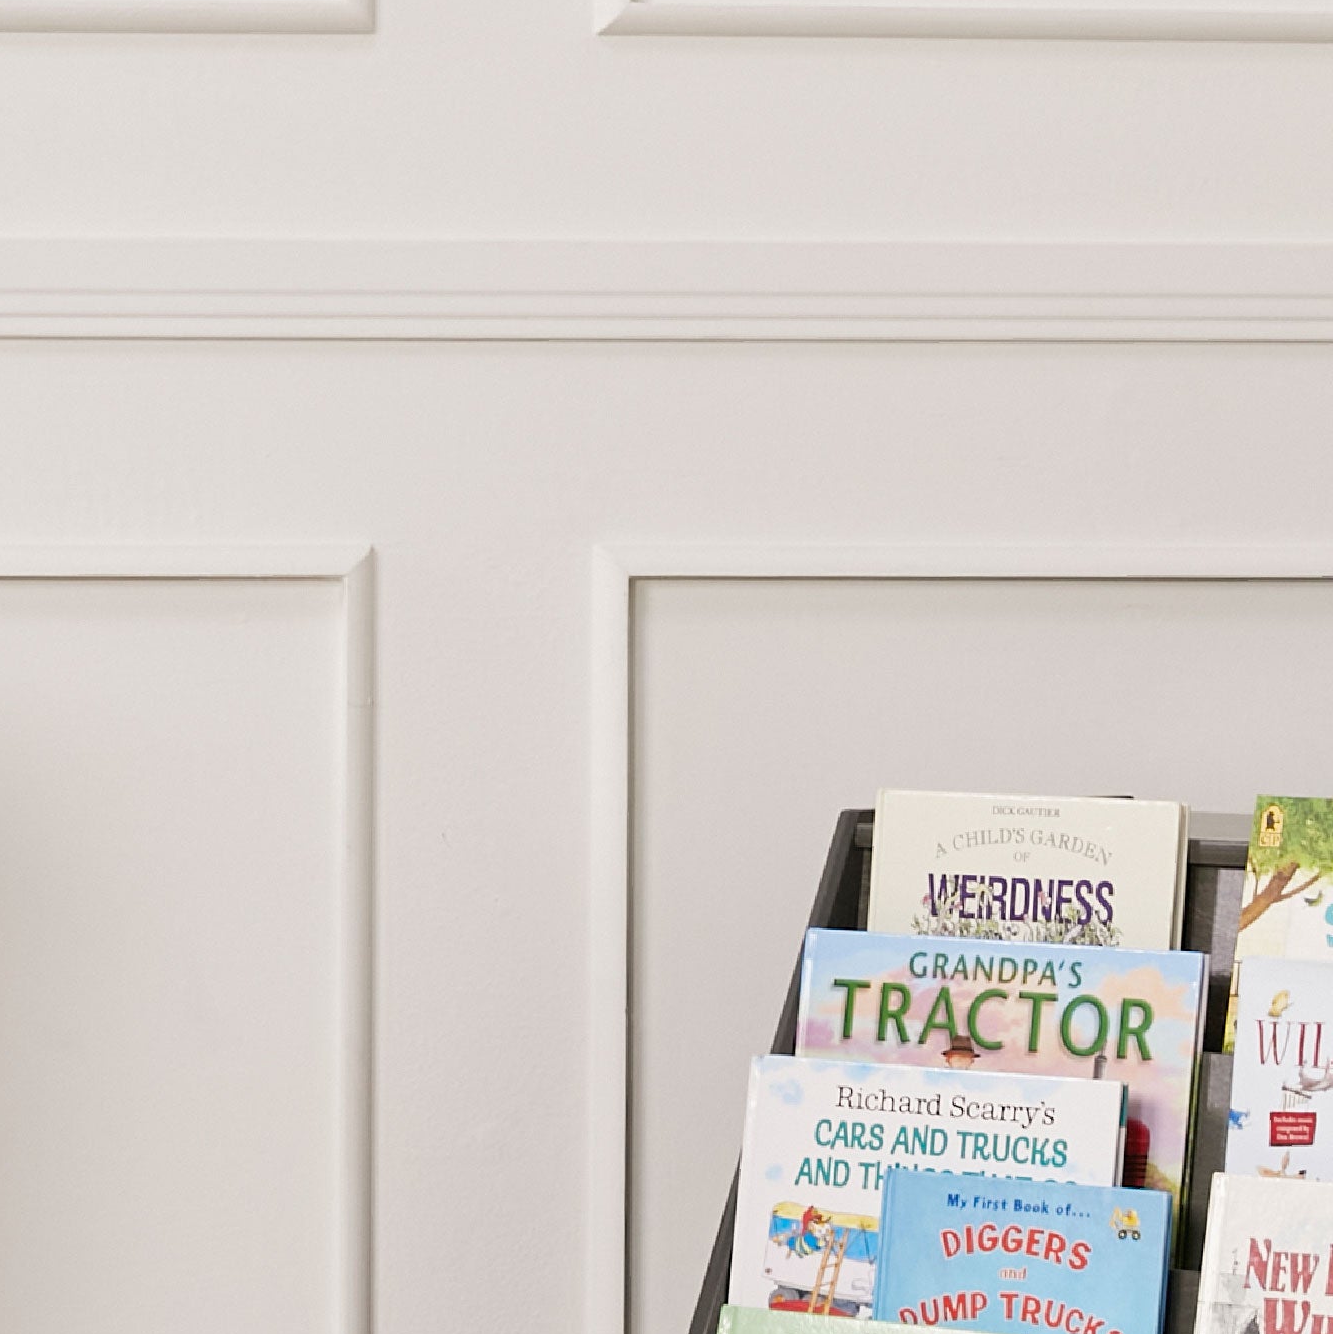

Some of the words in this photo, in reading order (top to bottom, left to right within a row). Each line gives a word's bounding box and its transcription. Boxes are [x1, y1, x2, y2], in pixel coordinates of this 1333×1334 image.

[935, 842, 948, 860] A
[952, 827, 1025, 851] CHILD'S
[1030, 829, 1113, 866] GARDEN
[1013, 850, 1031, 863] OF
[928, 873, 1115, 926] WEIRDNESS
[909, 951, 1084, 988] GRANDPA'S
[833, 978, 1155, 1061] TRACTOR
[835, 1085, 942, 1116] Richard
[949, 1094, 1056, 1129] Scarry's
[814, 1119, 884, 1151] CARS
[890, 1124, 948, 1156] AND
[957, 1130, 1069, 1168] TRUCKS
[794, 1156, 851, 1188] AND
[946, 1193, 968, 1209] My
[973, 1195, 1008, 1211] First
[1013, 1198, 1049, 1214] Book
[939, 1223, 1093, 1271] DIGGERS
[998, 1267, 1028, 1280] and
[898, 1291, 988, 1327] DUMP
